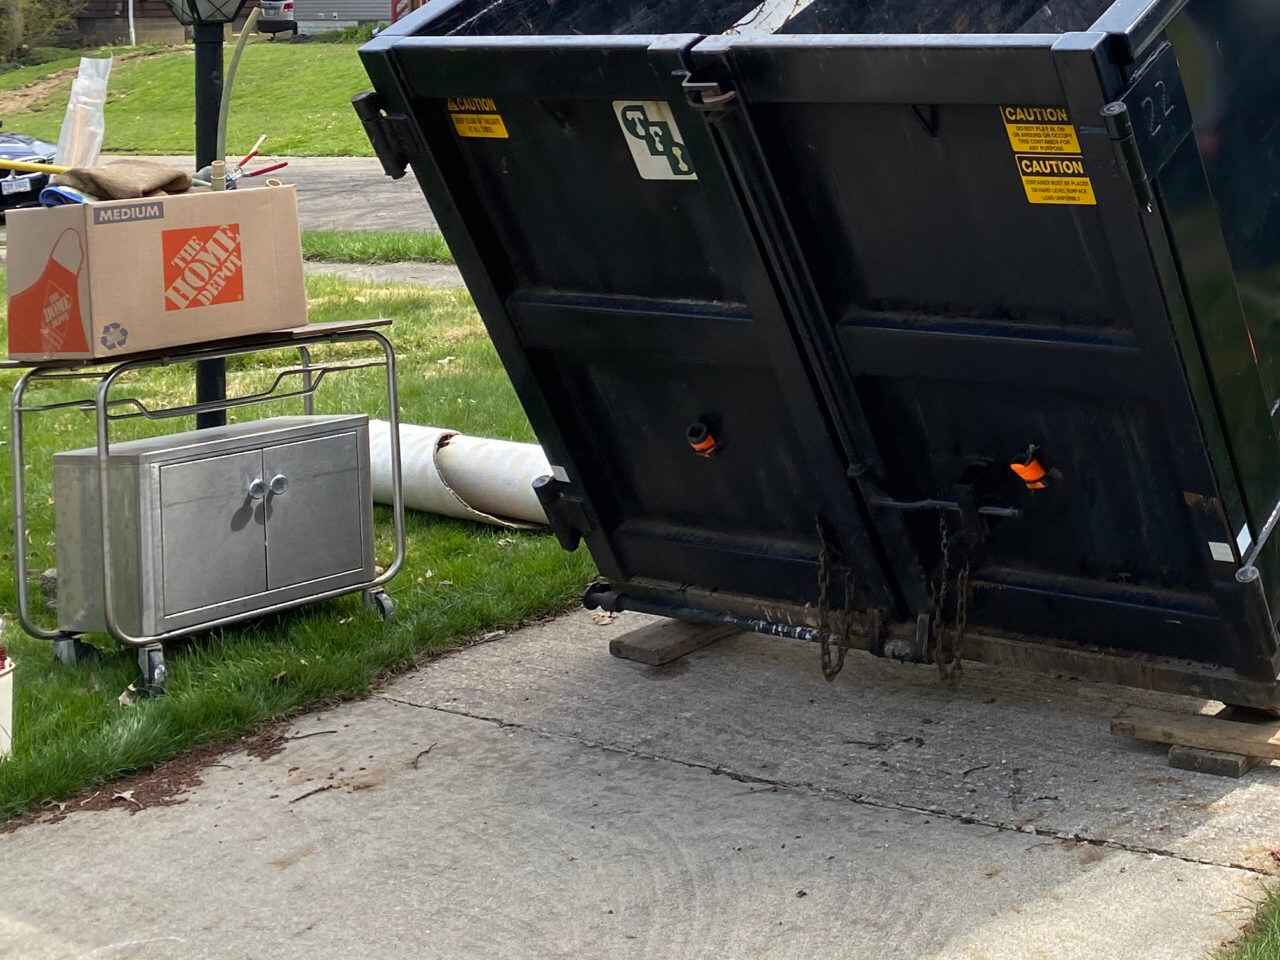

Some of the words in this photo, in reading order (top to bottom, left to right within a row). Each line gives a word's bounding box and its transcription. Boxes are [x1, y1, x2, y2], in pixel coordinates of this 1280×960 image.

[456, 96, 497, 112] CAUTION
[1005, 107, 1068, 122] CAUTION
[1021, 160, 1085, 174] CAUTION
[98, 205, 161, 223] MEDIUM
[171, 236, 205, 269] THE
[165, 224, 241, 309] HOME
[197, 251, 242, 305] DEPOT
